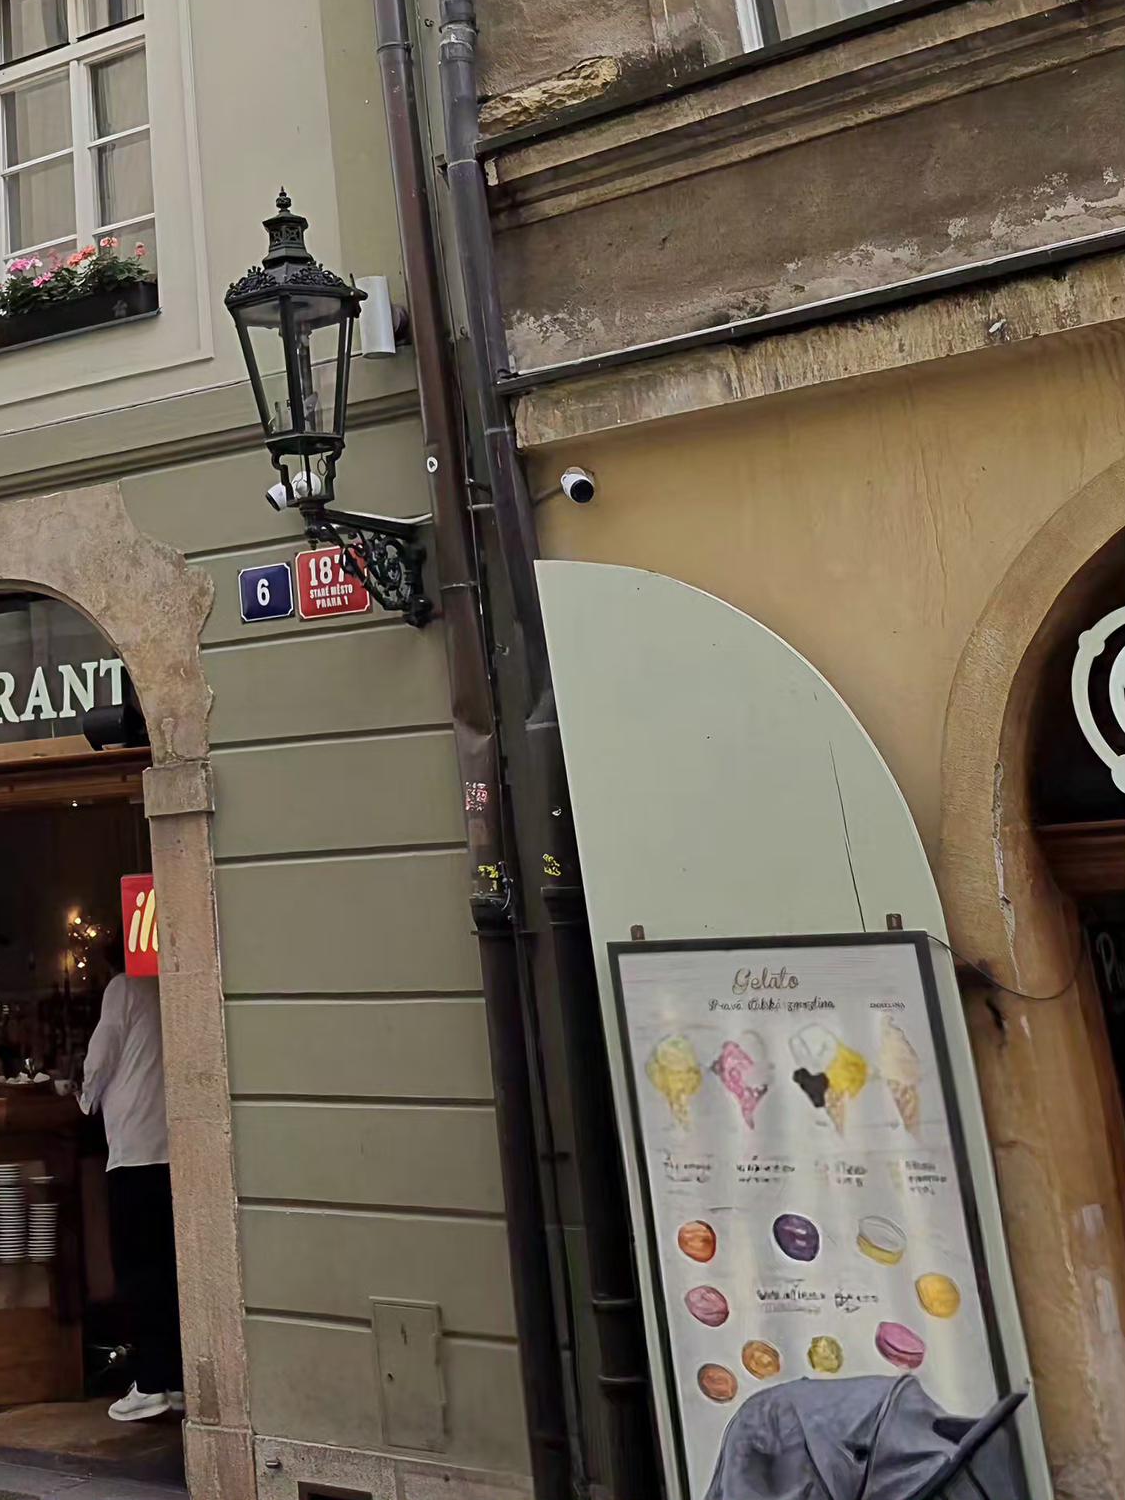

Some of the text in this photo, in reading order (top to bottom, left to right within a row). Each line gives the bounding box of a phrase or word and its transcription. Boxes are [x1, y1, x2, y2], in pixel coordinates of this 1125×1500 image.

[257, 578, 270, 606] 6
[310, 583, 353, 599] STARÉ MĚSTO
[316, 596, 342, 609] PRAHA
[732, 966, 799, 995] Gelato
